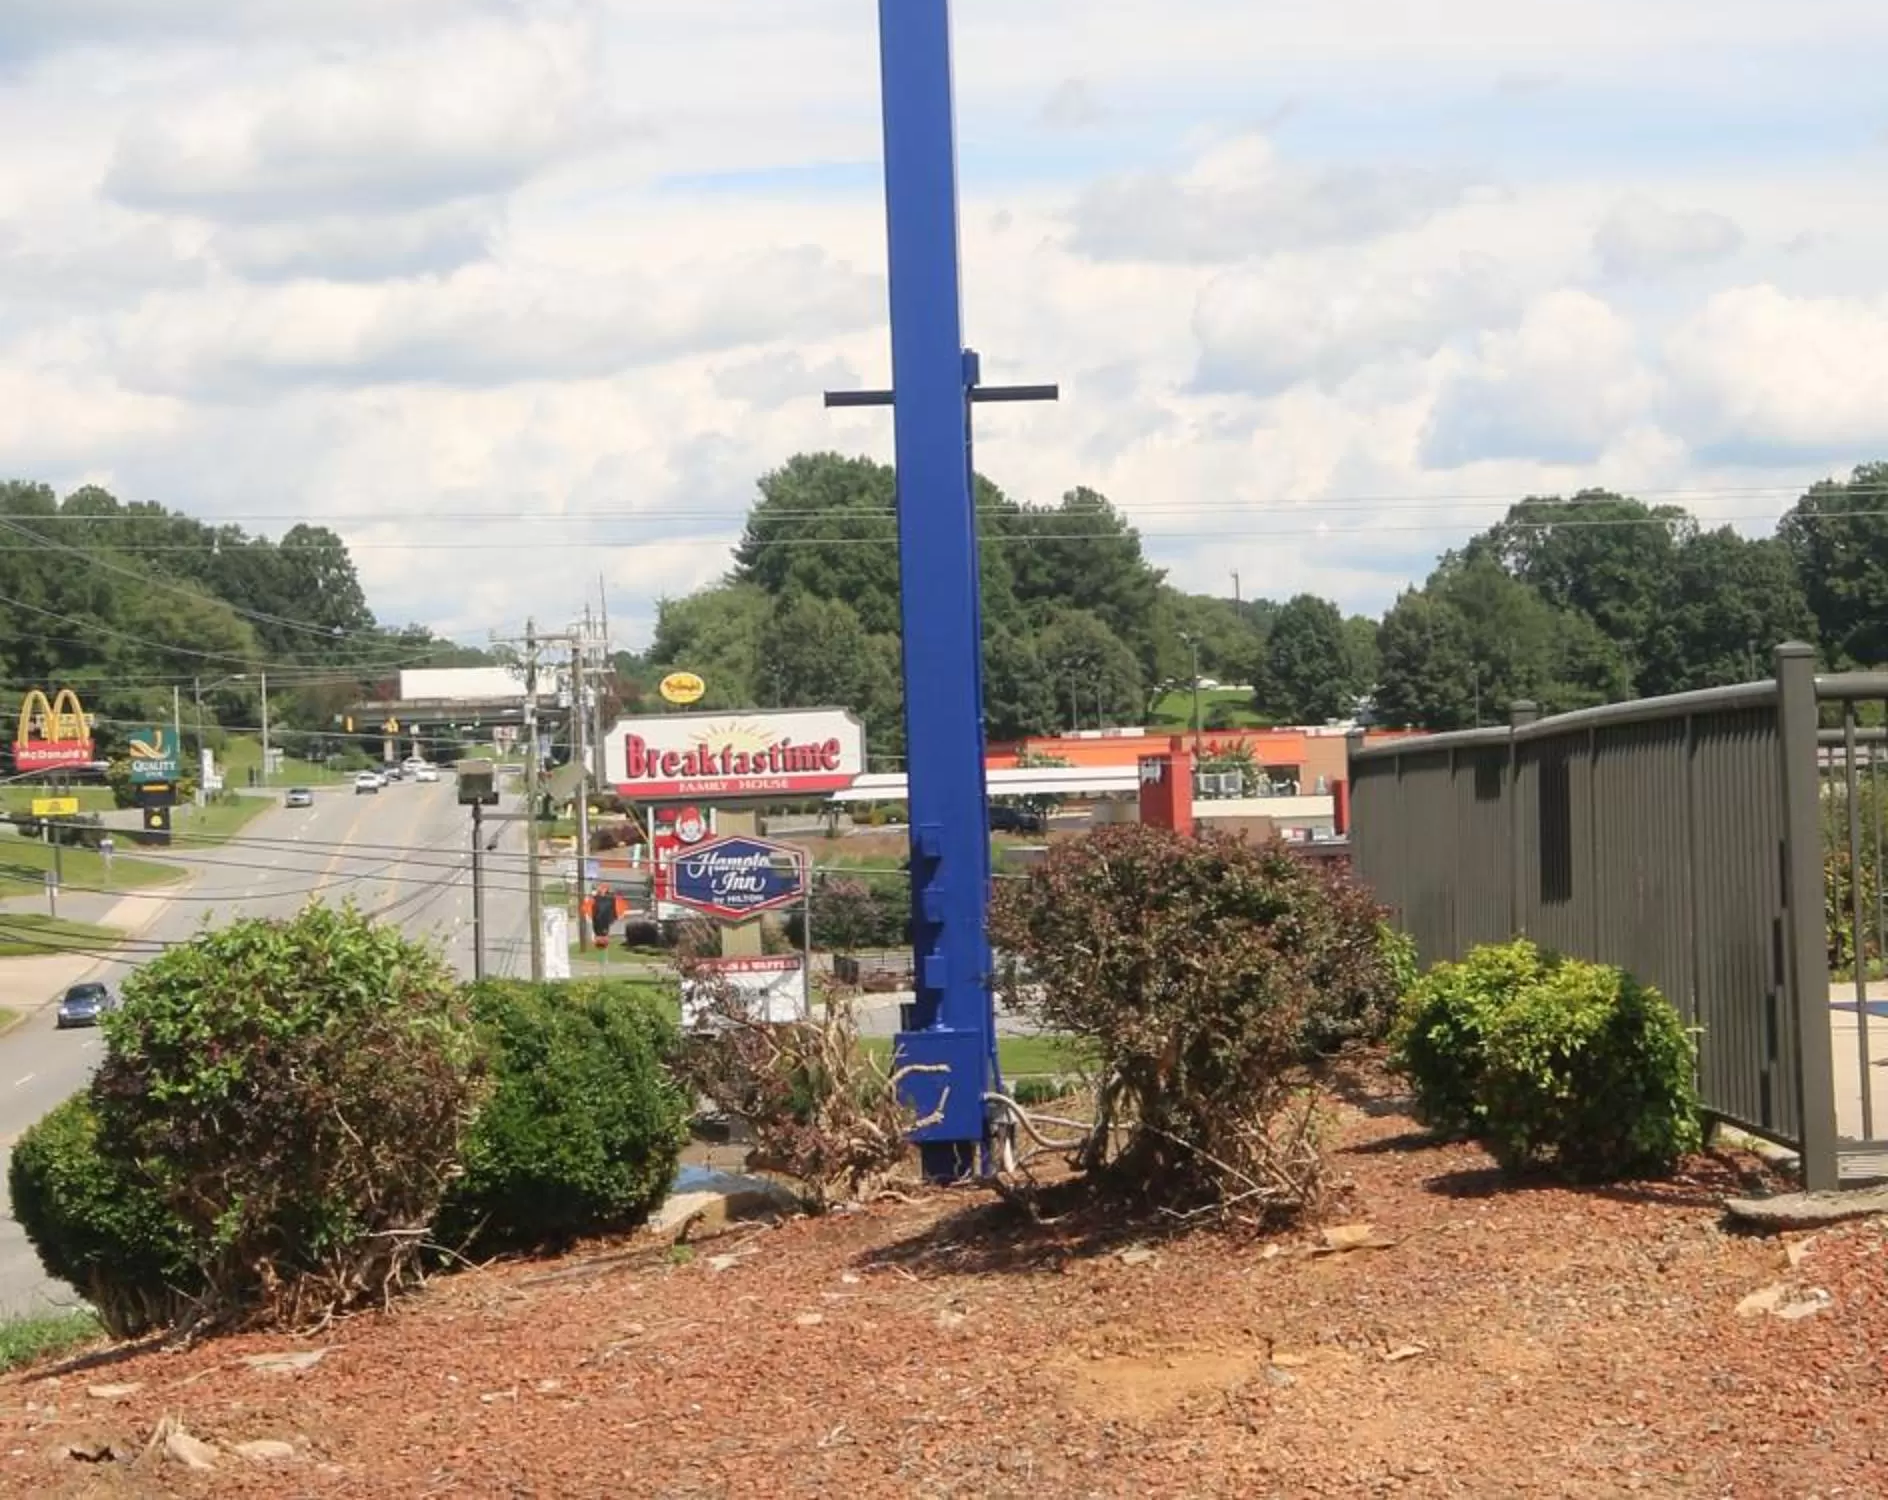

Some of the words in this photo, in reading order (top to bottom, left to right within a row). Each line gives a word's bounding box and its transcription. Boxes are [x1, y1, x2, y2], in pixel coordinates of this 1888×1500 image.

[19, 749, 89, 761] McDonald's
[625, 734, 841, 778] Breakfastime
[679, 781, 729, 793] FAMILY
[738, 779, 789, 790] HOUSE
[687, 851, 798, 879] Hampto
[711, 871, 766, 895] Inn
